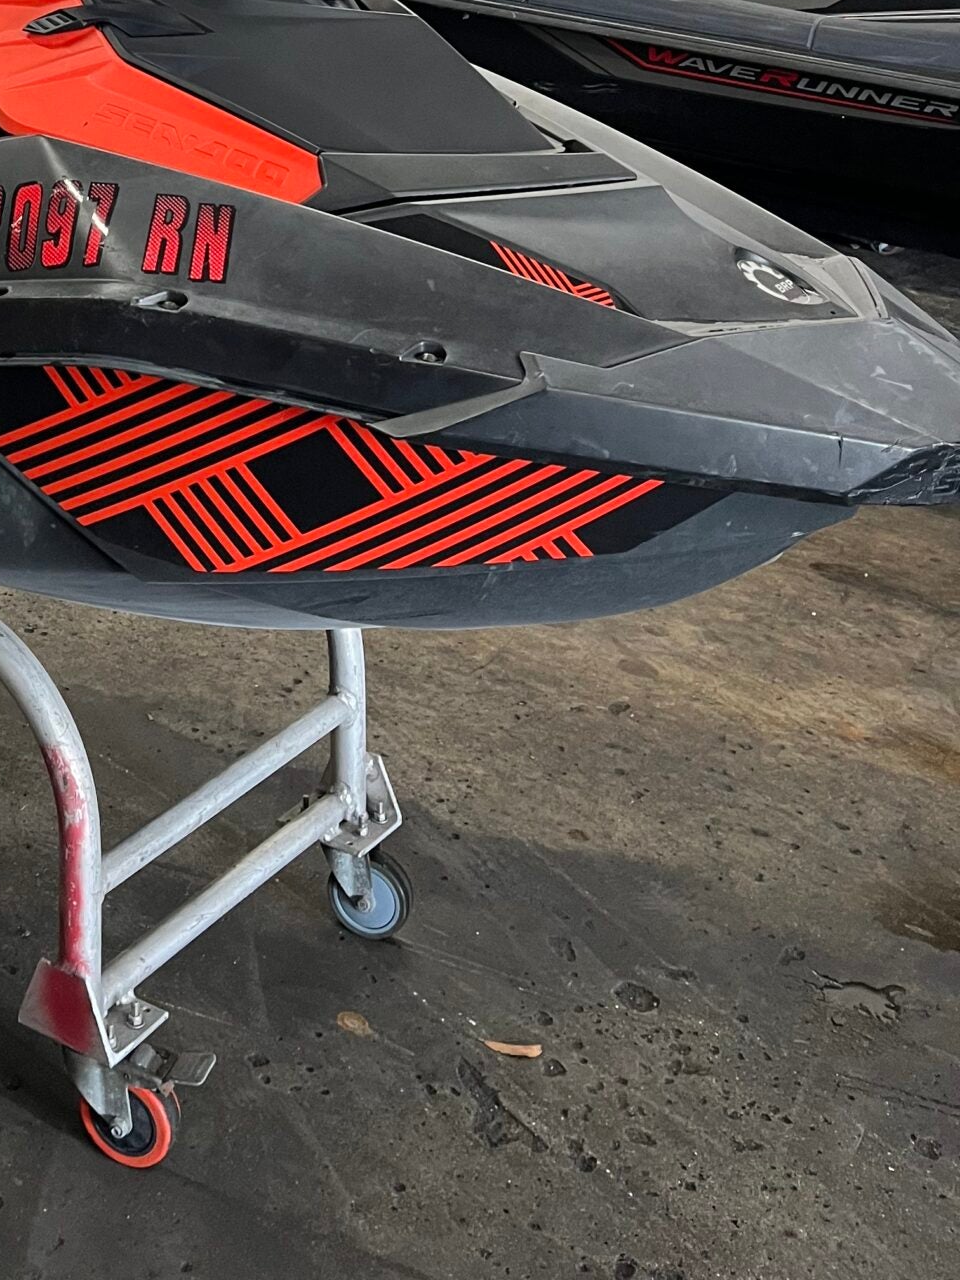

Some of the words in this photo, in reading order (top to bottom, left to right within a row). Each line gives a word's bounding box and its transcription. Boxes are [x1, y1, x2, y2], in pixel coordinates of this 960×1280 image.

[647, 47, 960, 117] WAVERUNNER
[141, 193, 236, 284] RN
[774, 279, 794, 293] BRP
